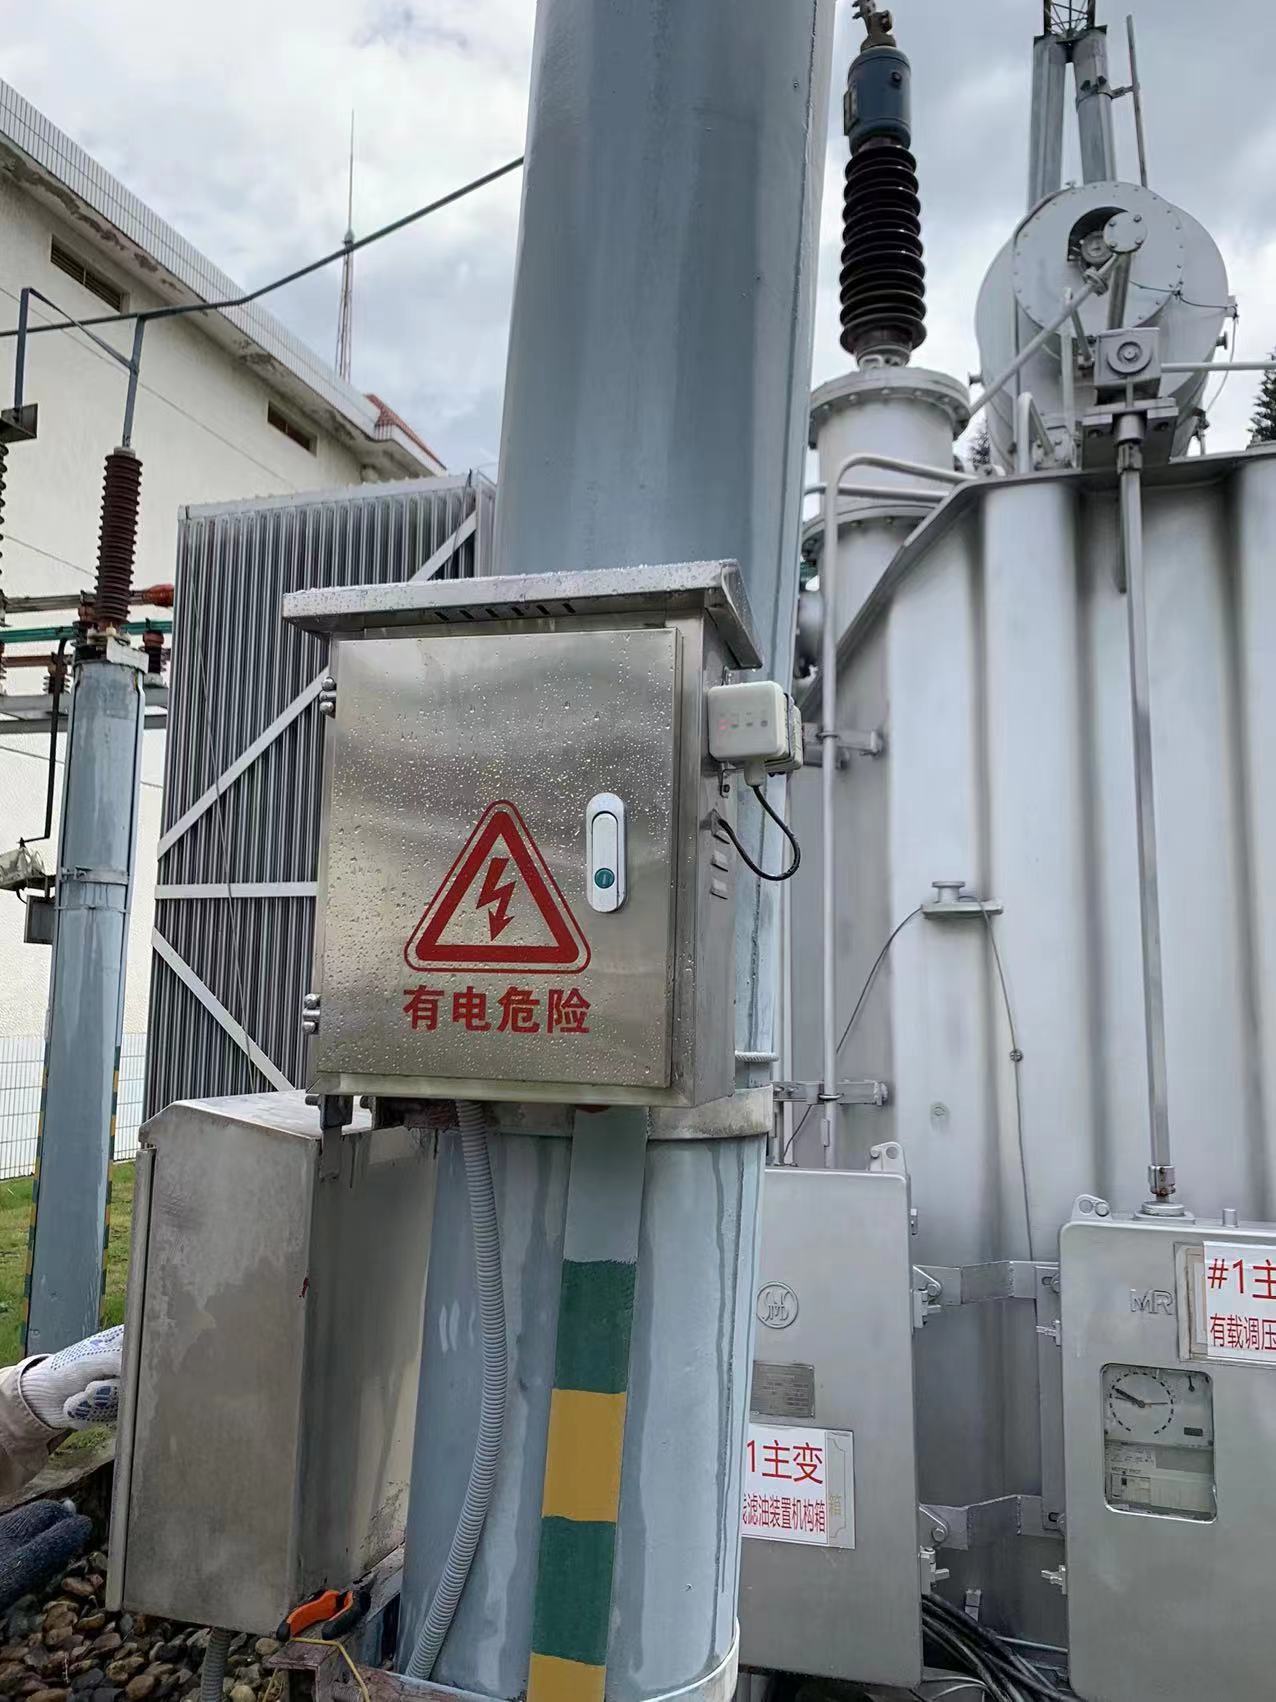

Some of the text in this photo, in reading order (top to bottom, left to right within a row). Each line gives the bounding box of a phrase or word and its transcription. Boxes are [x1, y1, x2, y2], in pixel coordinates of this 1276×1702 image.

[403, 985, 591, 1034] 有电危险
[1130, 1288, 1174, 1316] MR
[1209, 1313, 1276, 1350] 有载调压
